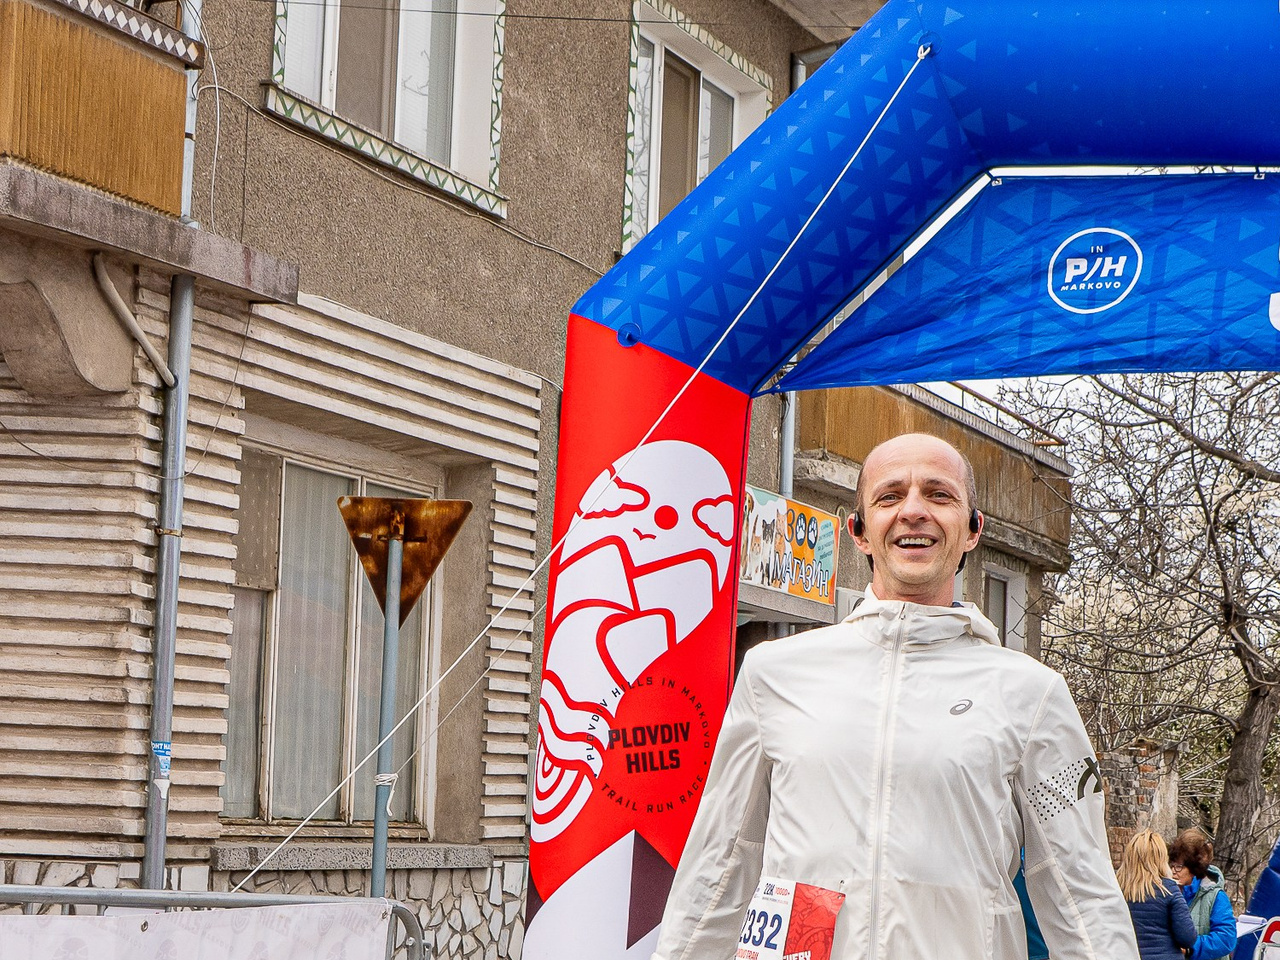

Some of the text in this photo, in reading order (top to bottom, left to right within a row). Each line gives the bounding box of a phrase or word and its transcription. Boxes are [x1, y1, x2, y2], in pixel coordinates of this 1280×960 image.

[1064, 256, 1127, 283] P/H
[1060, 281, 1121, 291] MARKOVO
[773, 551, 829, 597] МАГАЗИН
[586, 677, 711, 761] PLOVDIV HILLS IN MARKOVO
[608, 721, 691, 750] PLOVDIV
[625, 748, 681, 774] HILLS
[601, 774, 703, 813] TRAIL RUN RACE
